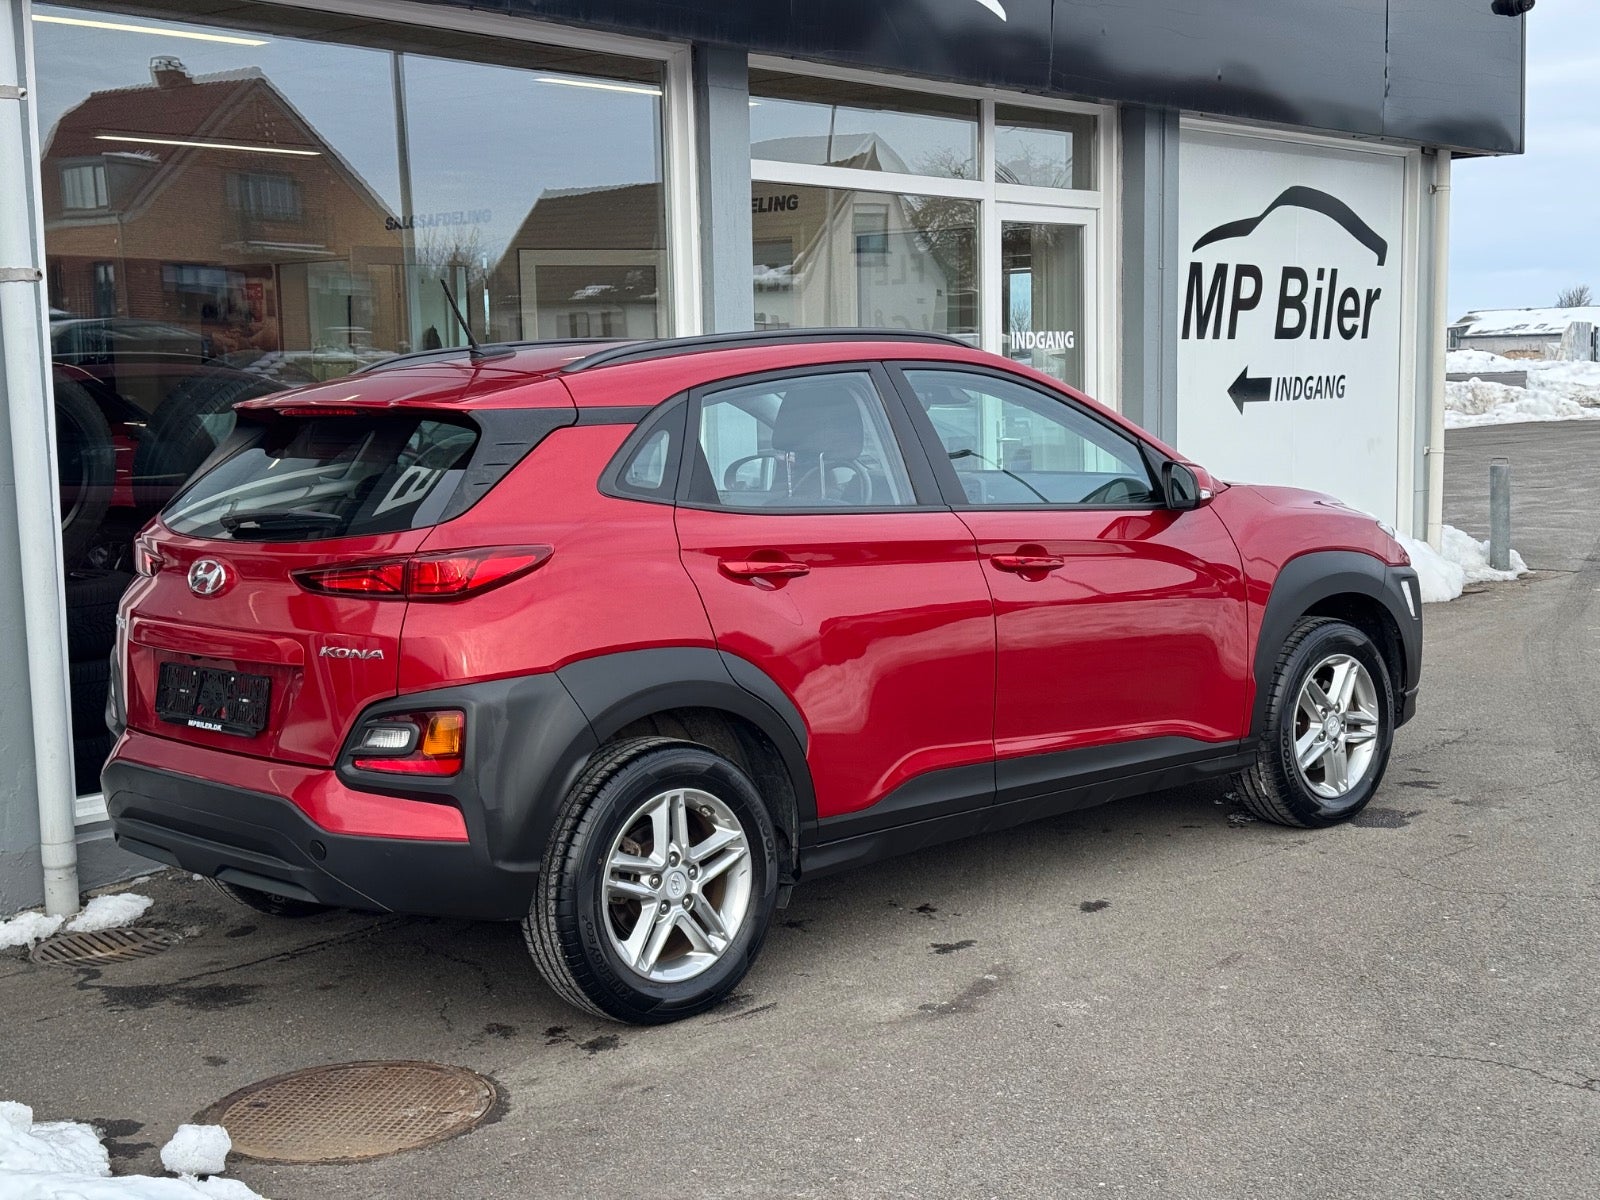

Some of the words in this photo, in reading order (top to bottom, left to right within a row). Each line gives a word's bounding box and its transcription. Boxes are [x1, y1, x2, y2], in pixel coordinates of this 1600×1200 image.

[1181, 262, 1263, 340] MP
[1274, 266, 1382, 341] Biler
[1011, 331, 1074, 349] INDGANG
[1275, 374, 1346, 402] INDGANG
[319, 645, 384, 660] KONA
